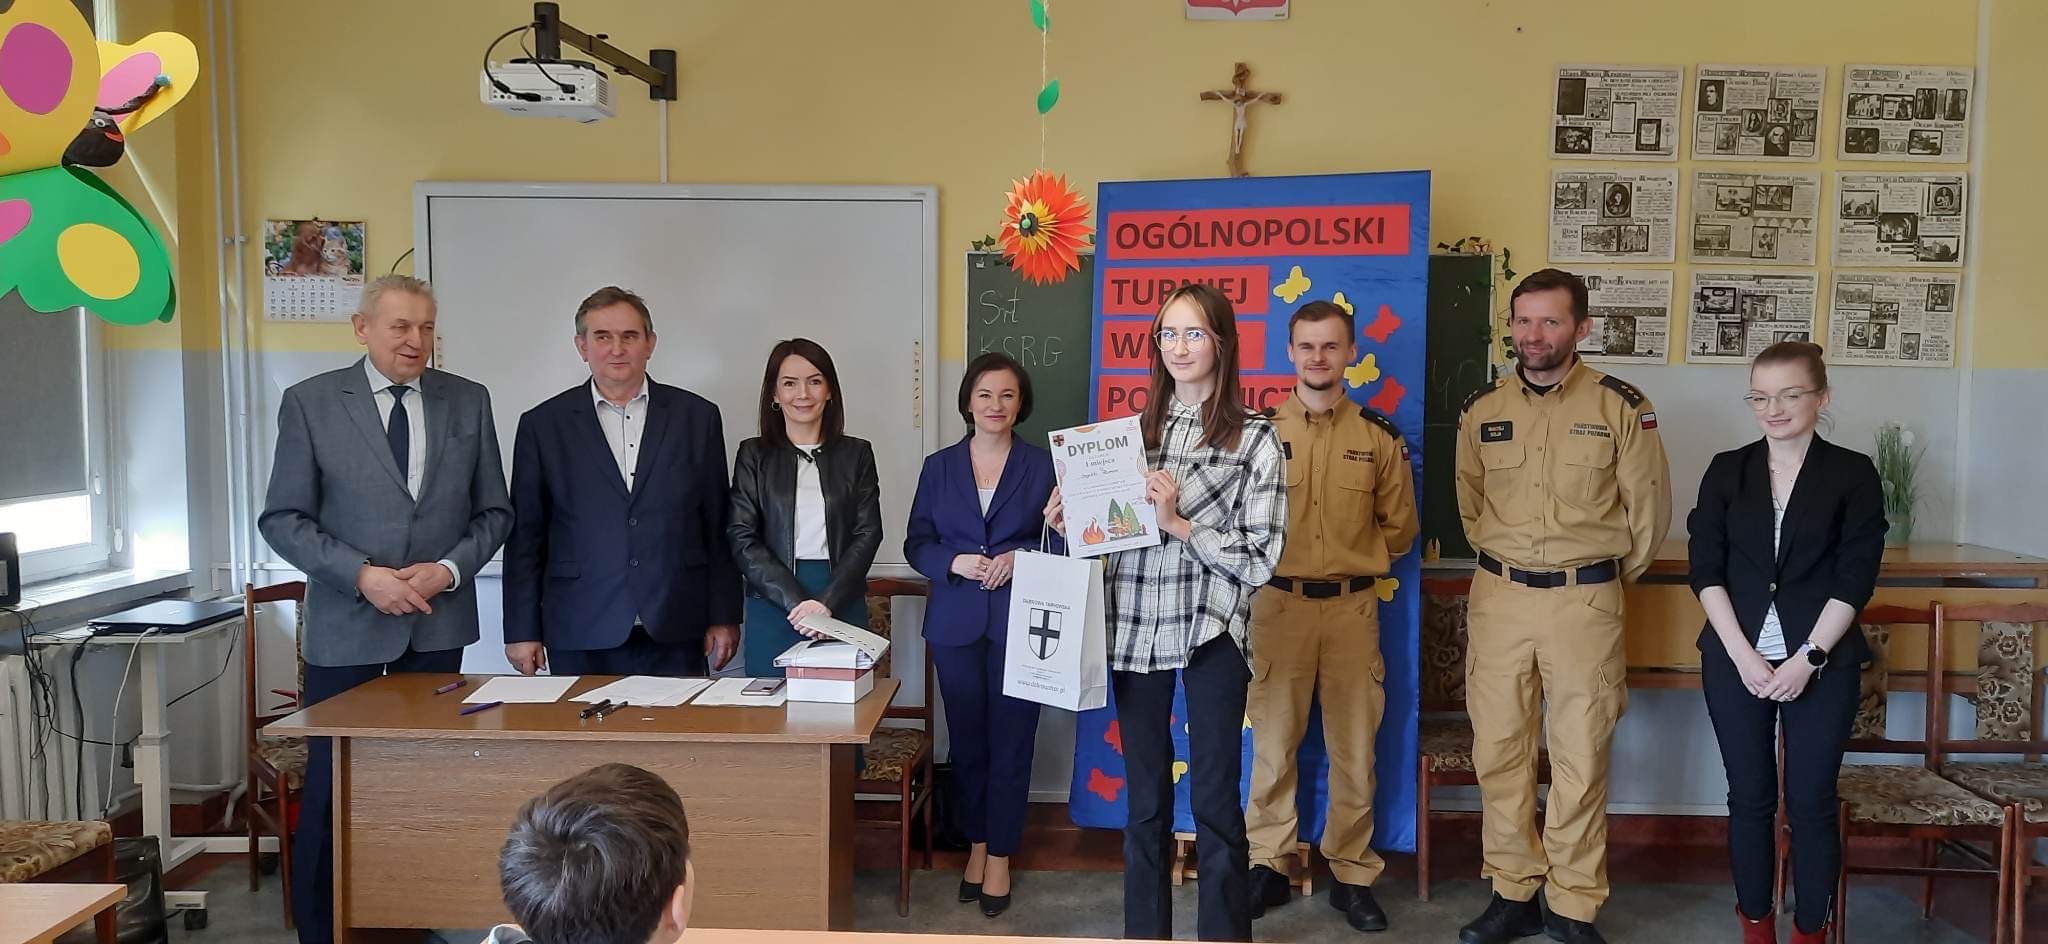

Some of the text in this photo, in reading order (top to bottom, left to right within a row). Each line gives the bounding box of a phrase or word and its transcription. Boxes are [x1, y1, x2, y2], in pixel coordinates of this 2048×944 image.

[1115, 215, 1385, 250] OGÓLNOPOLSKI
[1111, 278, 1247, 305] TUREJ
[980, 336, 1063, 368] KSRG
[1068, 435, 1128, 457] DYPLOM
